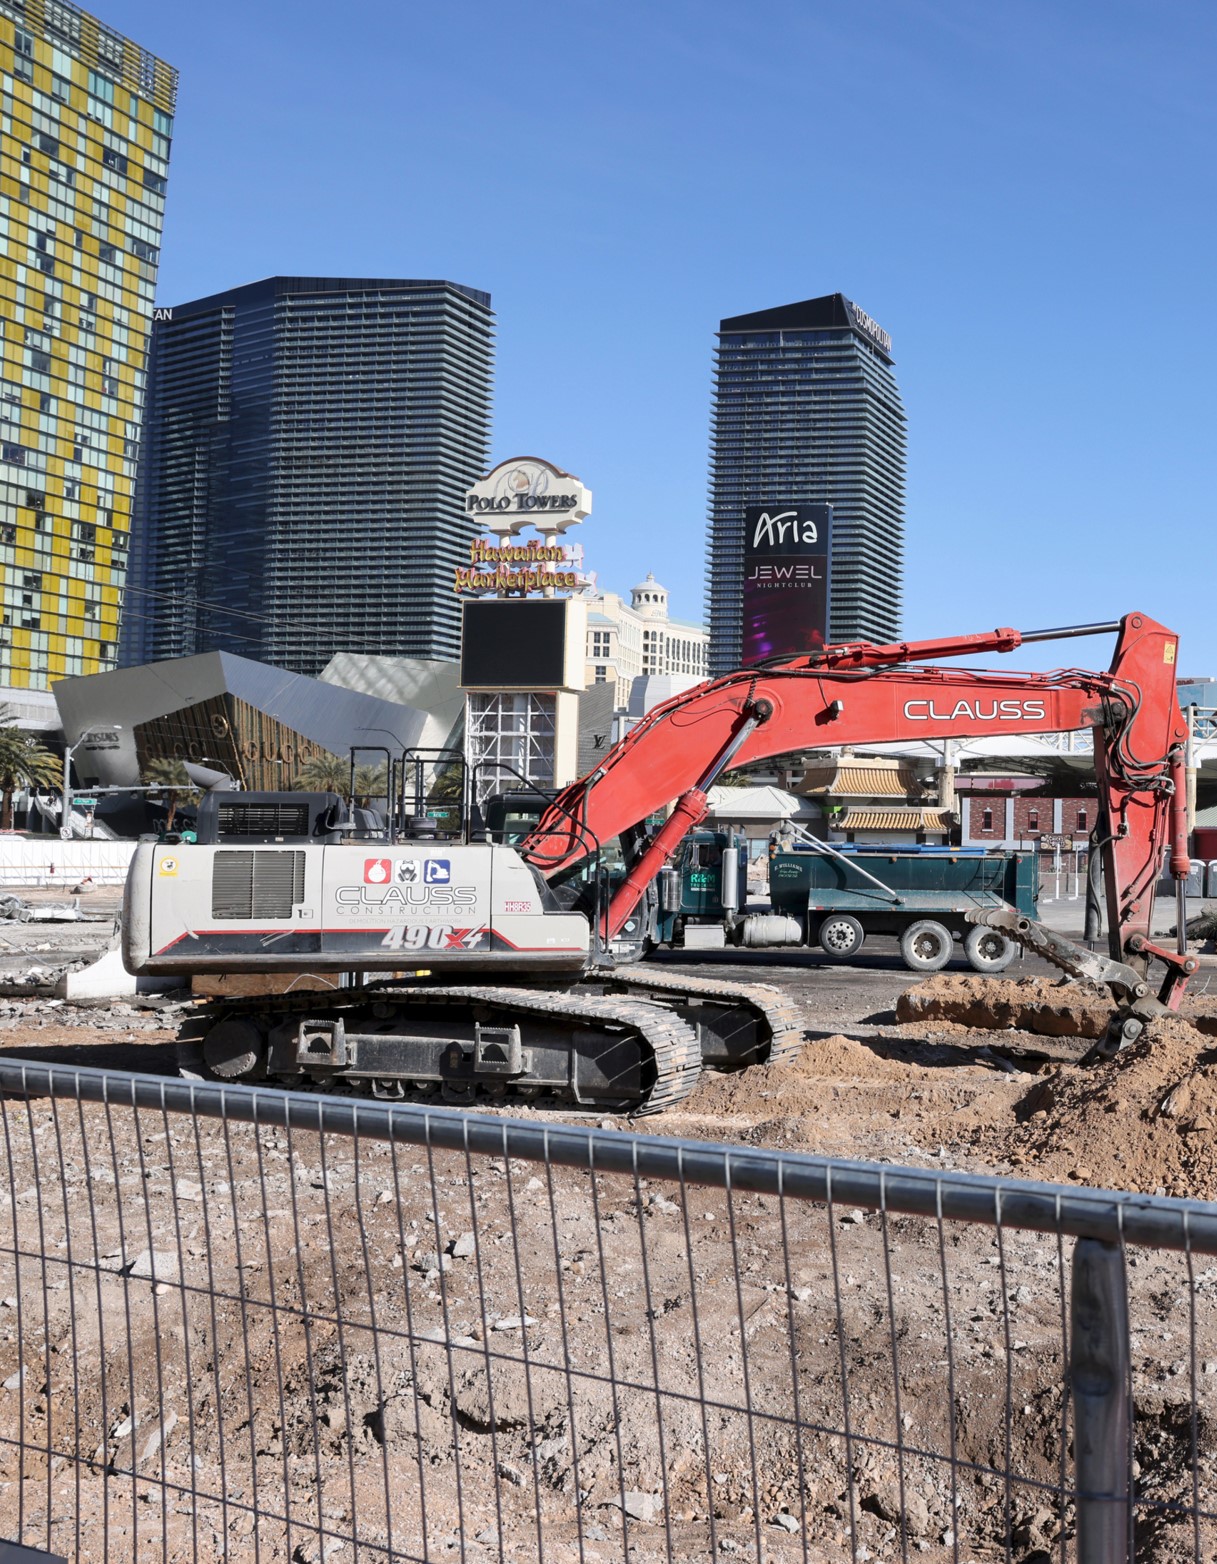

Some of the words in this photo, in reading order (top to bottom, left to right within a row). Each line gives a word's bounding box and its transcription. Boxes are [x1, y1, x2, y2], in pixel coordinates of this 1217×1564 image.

[467, 494, 511, 511] POLO
[513, 493, 578, 511] TOWERS
[753, 511, 817, 548] Aria
[469, 539, 567, 564] Hawaiian
[453, 563, 577, 593] Marketplace
[748, 565, 822, 579] JEWEL
[903, 700, 1046, 720] CLAUSS
[335, 886, 477, 906] CLAUSS
[336, 905, 476, 915] CONSTRUCTION
